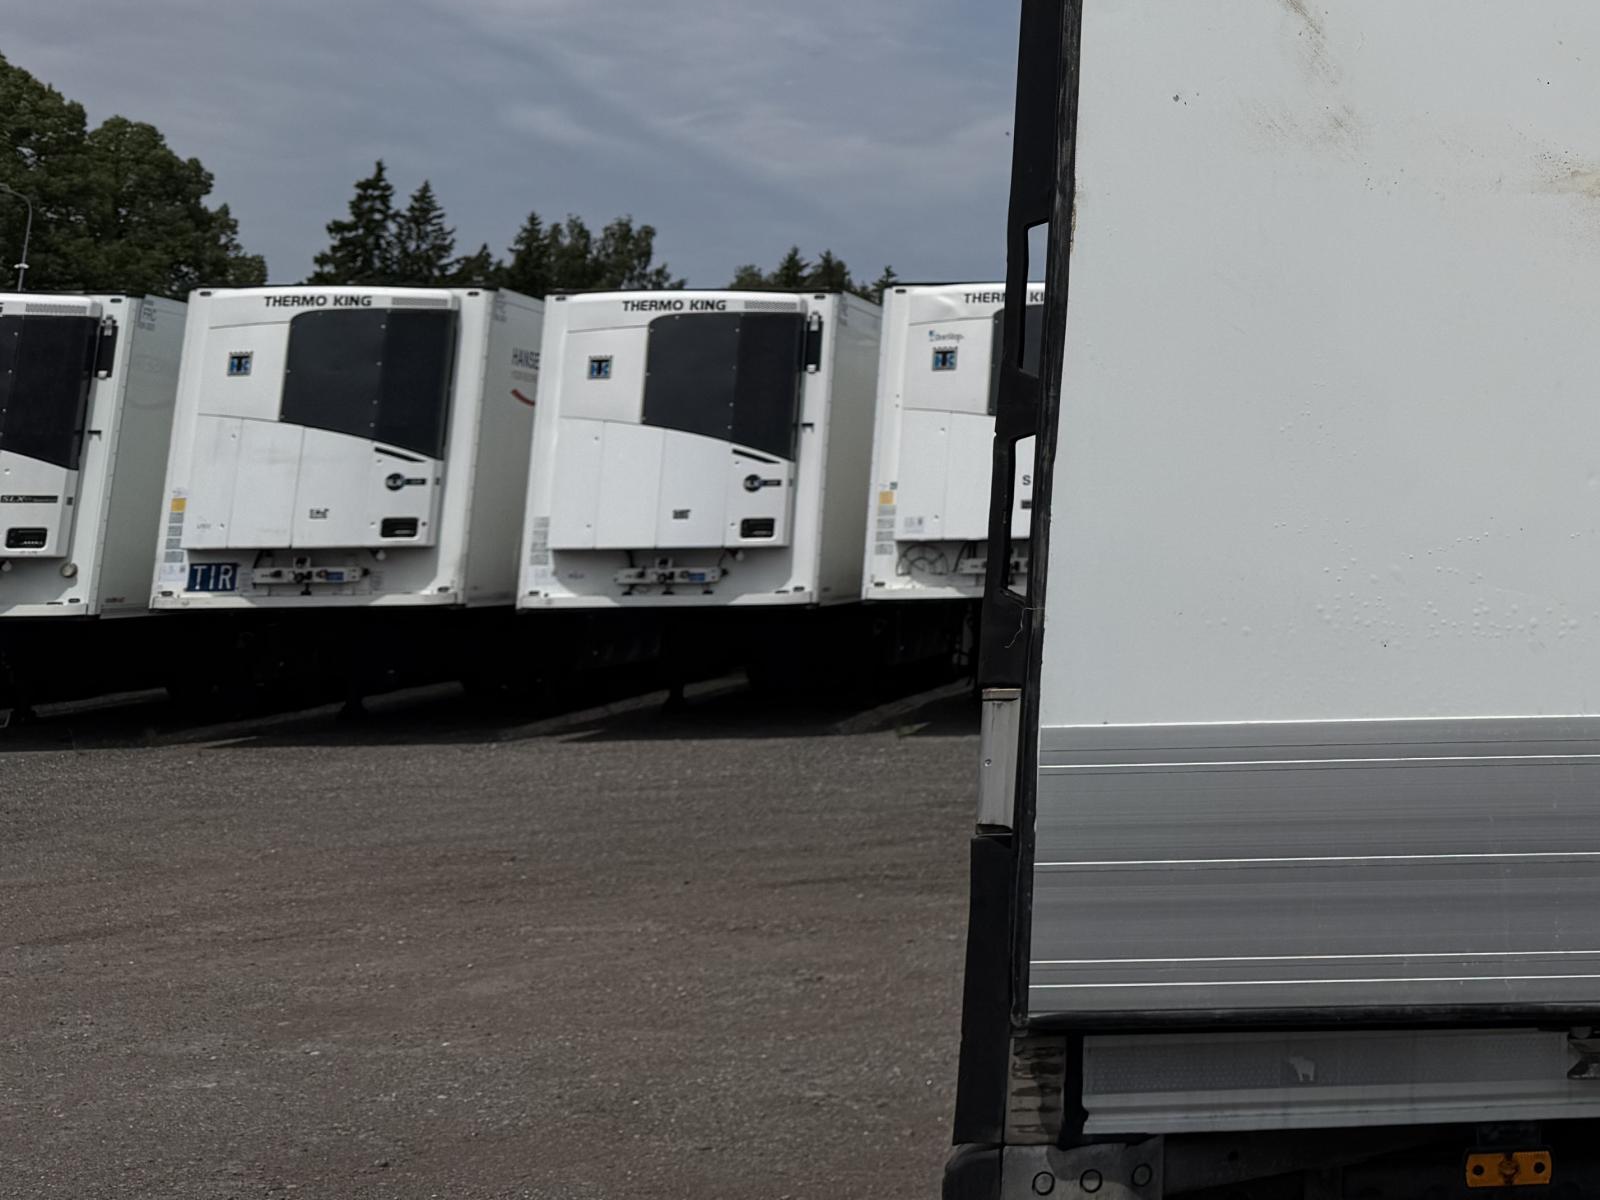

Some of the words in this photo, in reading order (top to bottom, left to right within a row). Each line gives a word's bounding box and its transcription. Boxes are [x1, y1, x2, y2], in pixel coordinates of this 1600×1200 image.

[264, 295, 327, 308] THERMO
[333, 295, 372, 307] KING
[964, 291, 1006, 304] THER
[622, 299, 684, 312] THERMO
[689, 299, 727, 311] KING
[192, 564, 233, 590] TIR
